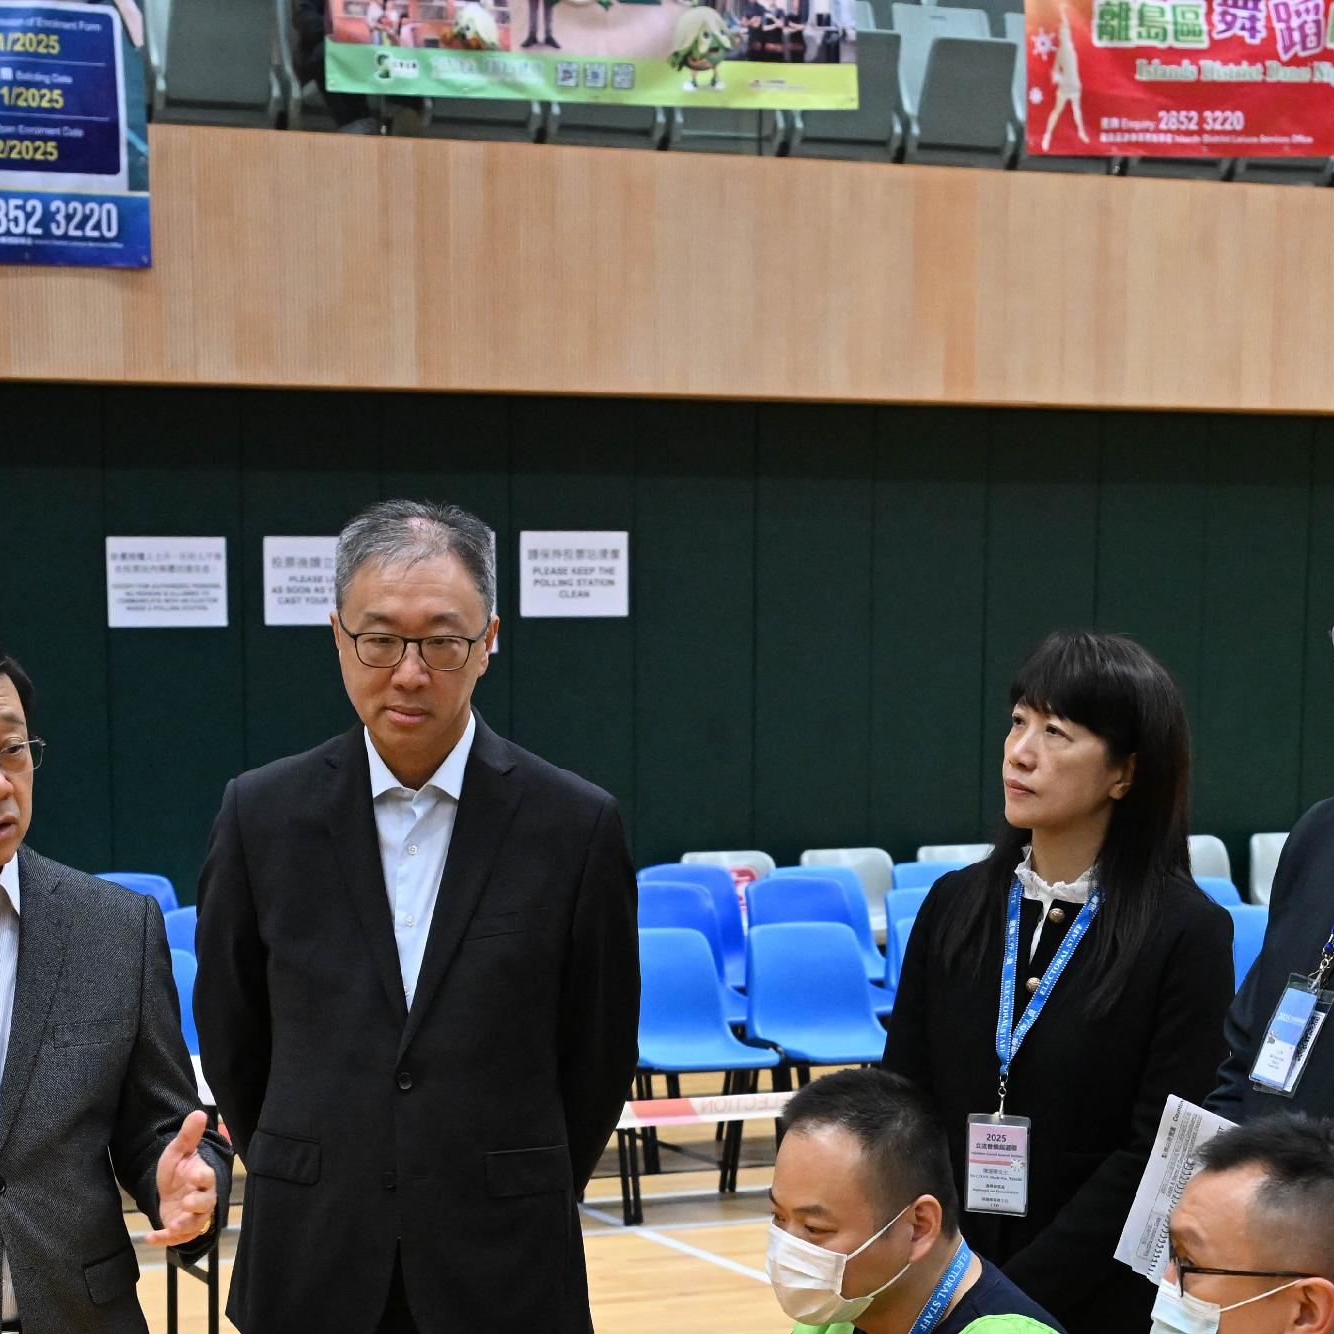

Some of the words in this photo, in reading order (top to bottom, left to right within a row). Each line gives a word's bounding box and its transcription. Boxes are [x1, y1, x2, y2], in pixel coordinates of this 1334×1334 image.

[49, 201, 118, 238] 3220
[533, 566, 567, 575] PLEASE
[571, 566, 595, 575] KEEP
[598, 566, 615, 575] THE
[533, 578, 573, 587] POLLING
[576, 578, 616, 587] STATION
[558, 590, 590, 599] CLEAN
[1039, 950, 1069, 996] ELECTORAL
[1066, 923, 1083, 951] STAFF
[986, 1133, 1007, 1143] 2025
[937, 1251, 968, 1298] ELECTORAL
[920, 1300, 941, 1332] STAFF
